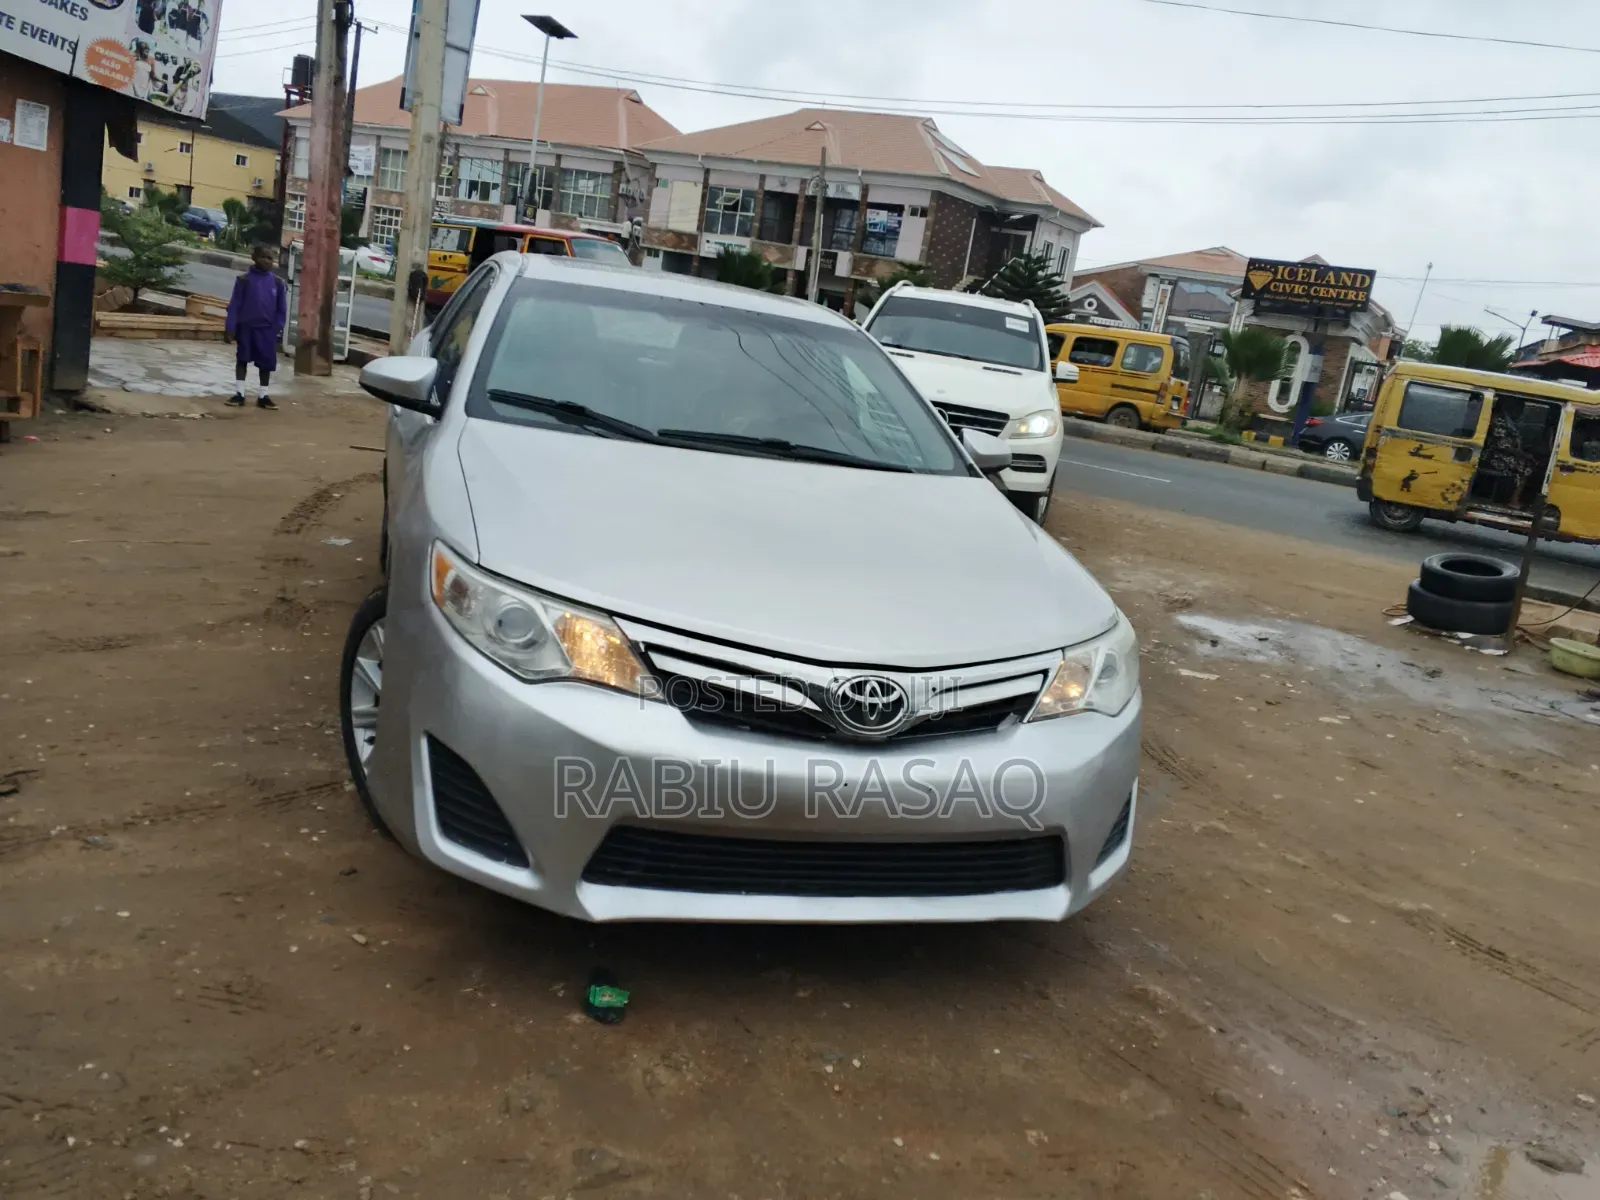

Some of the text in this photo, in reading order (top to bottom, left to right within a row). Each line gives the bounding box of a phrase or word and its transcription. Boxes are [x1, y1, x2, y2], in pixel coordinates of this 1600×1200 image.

[39, 0, 89, 21] AKES
[20, 20, 77, 55] EVENTS
[89, 65, 130, 82] AVAILABLE
[101, 58, 121, 71] ALSO
[1276, 265, 1371, 288] ICELAND
[1270, 282, 1308, 295] CIVIC
[1310, 286, 1368, 302] CENTRE
